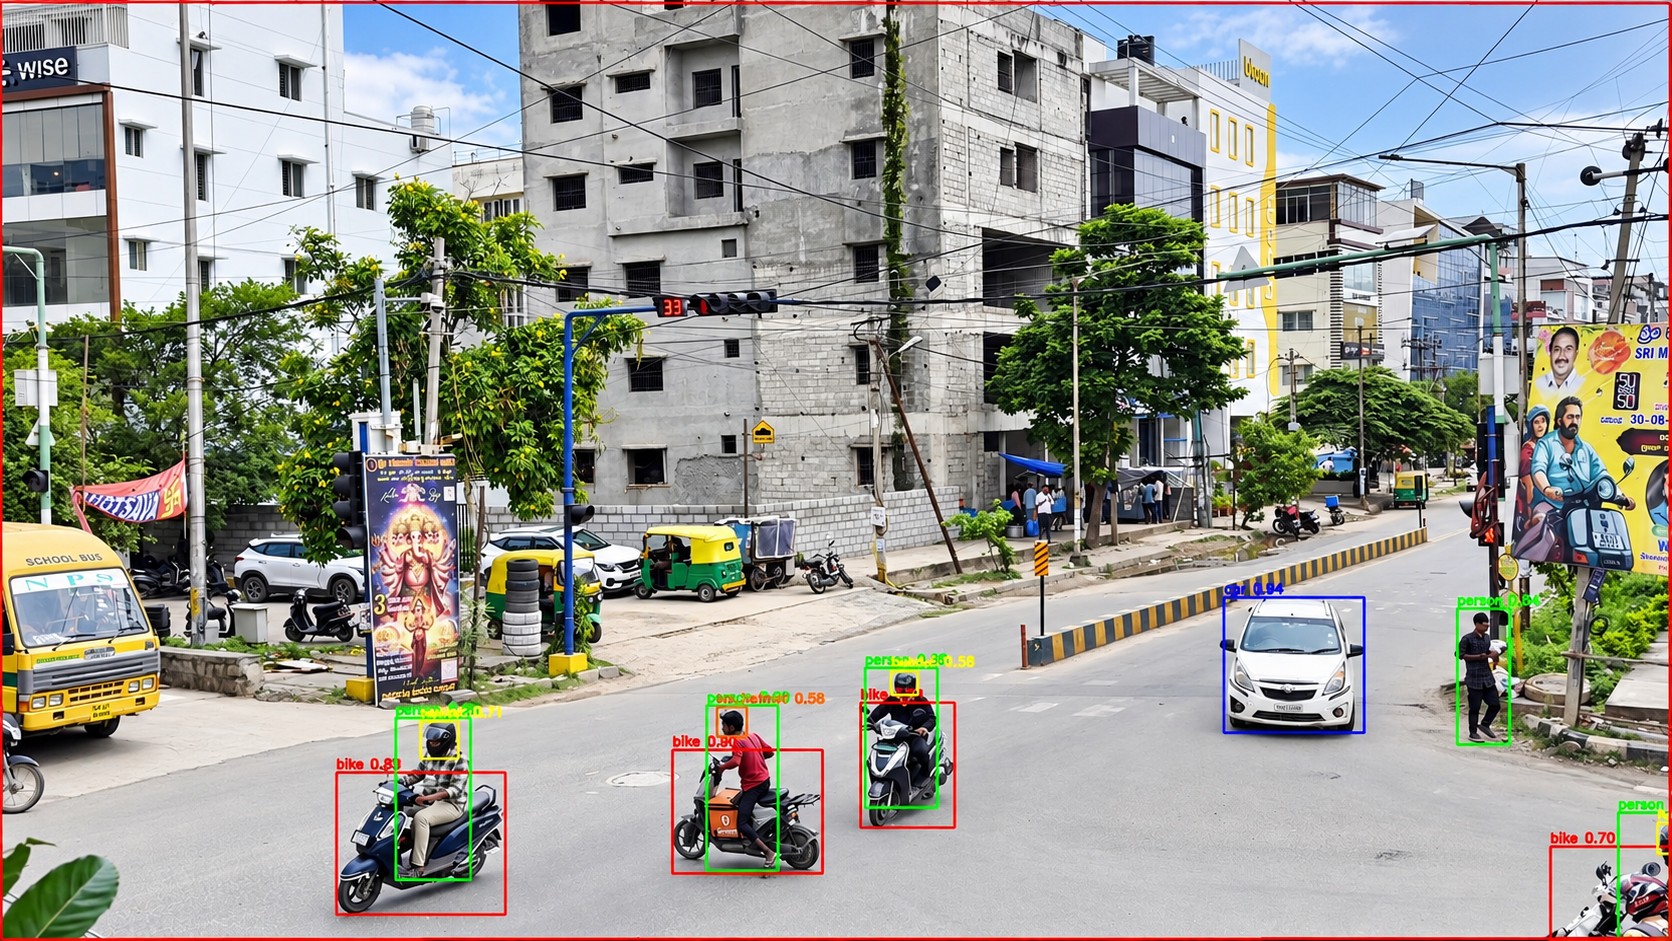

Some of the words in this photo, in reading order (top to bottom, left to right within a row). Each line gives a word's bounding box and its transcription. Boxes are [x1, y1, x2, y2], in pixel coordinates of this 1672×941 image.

[664, 299, 682, 316] 33
[1635, 347, 1655, 359] SRI
[26, 554, 77, 567] SCHOOL
[79, 553, 103, 562] BUS
[374, 594, 387, 615] 3
